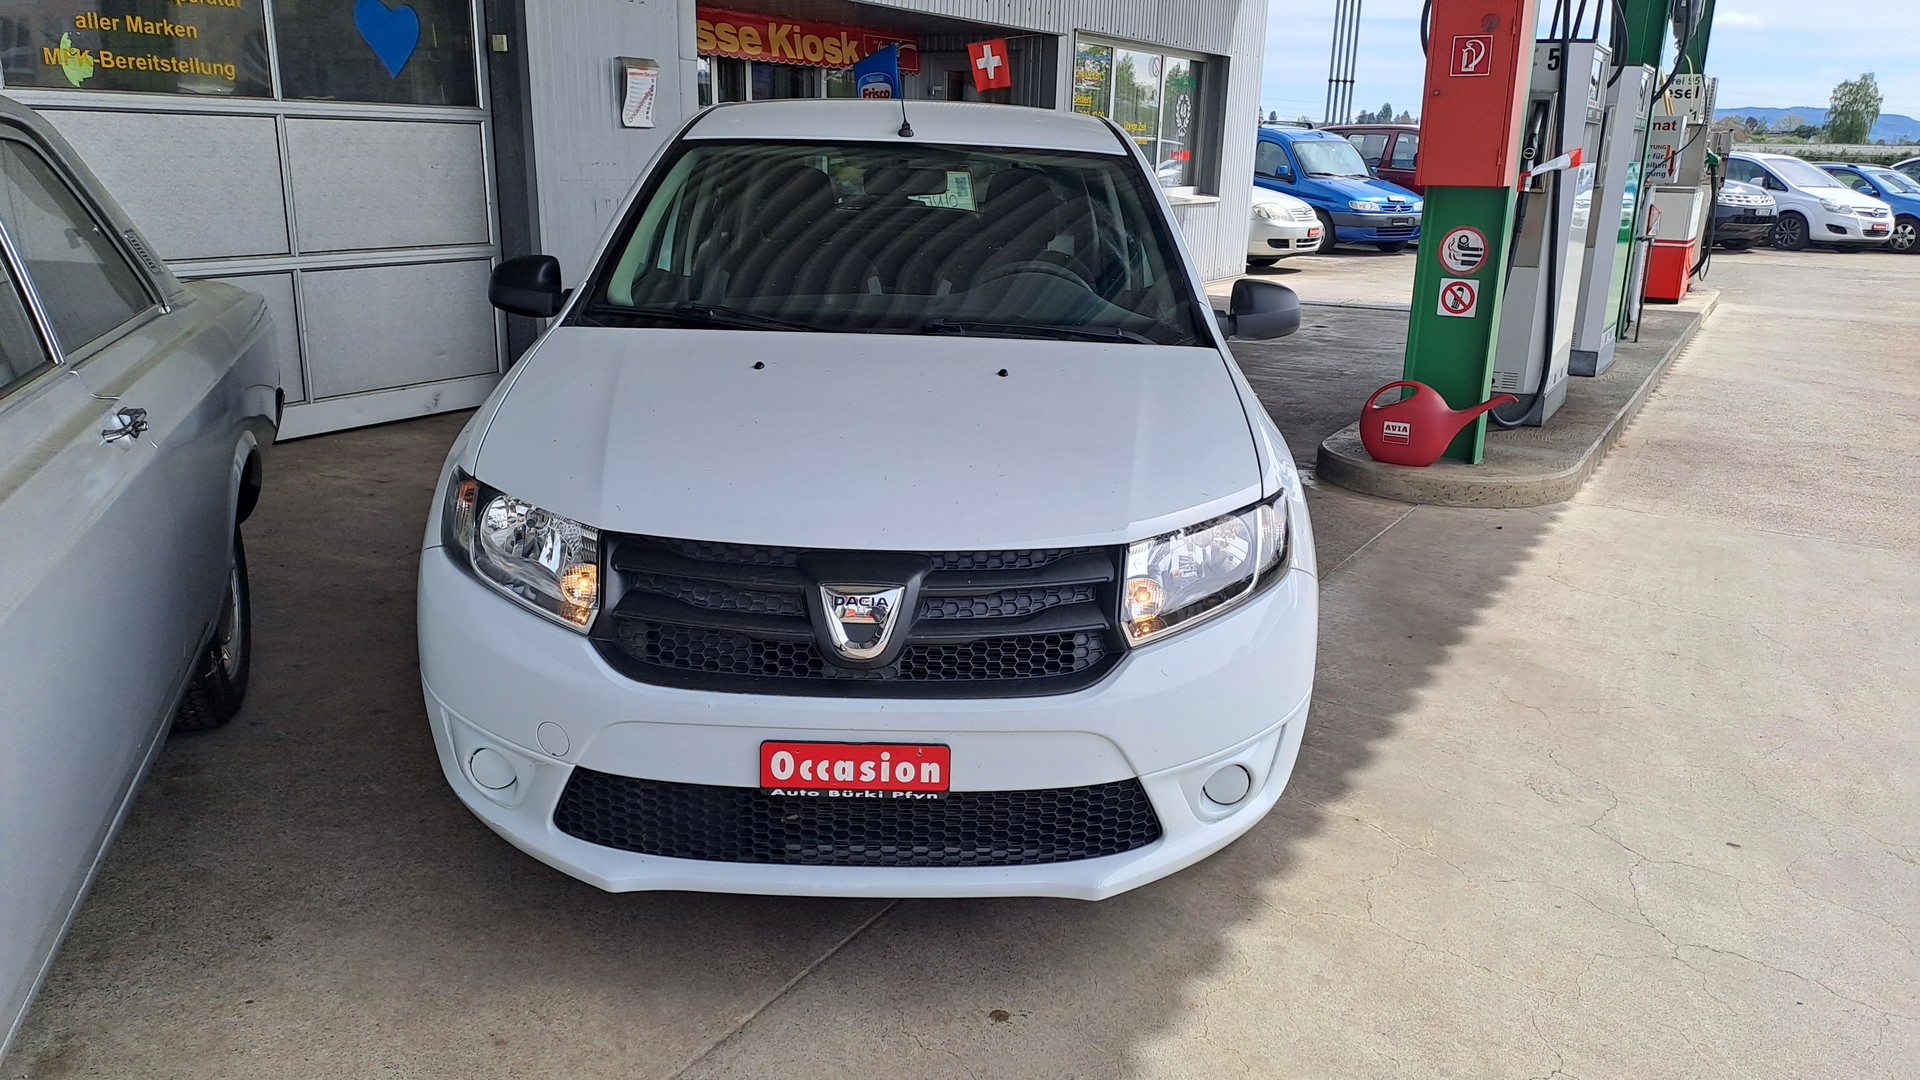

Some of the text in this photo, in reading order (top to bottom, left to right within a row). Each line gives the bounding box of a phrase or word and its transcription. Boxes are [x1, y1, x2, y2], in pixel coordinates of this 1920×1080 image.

[75, 12, 199, 39] aller Marken
[768, 22, 860, 64] Kiosk
[1547, 48, 1560, 71] 5
[862, 87, 891, 99] Frisco
[1384, 424, 1409, 433] AVIA
[833, 596, 888, 607] DACIA
[770, 750, 940, 783] Occasion
[770, 788, 938, 800] Auto Bürki Pfyn
